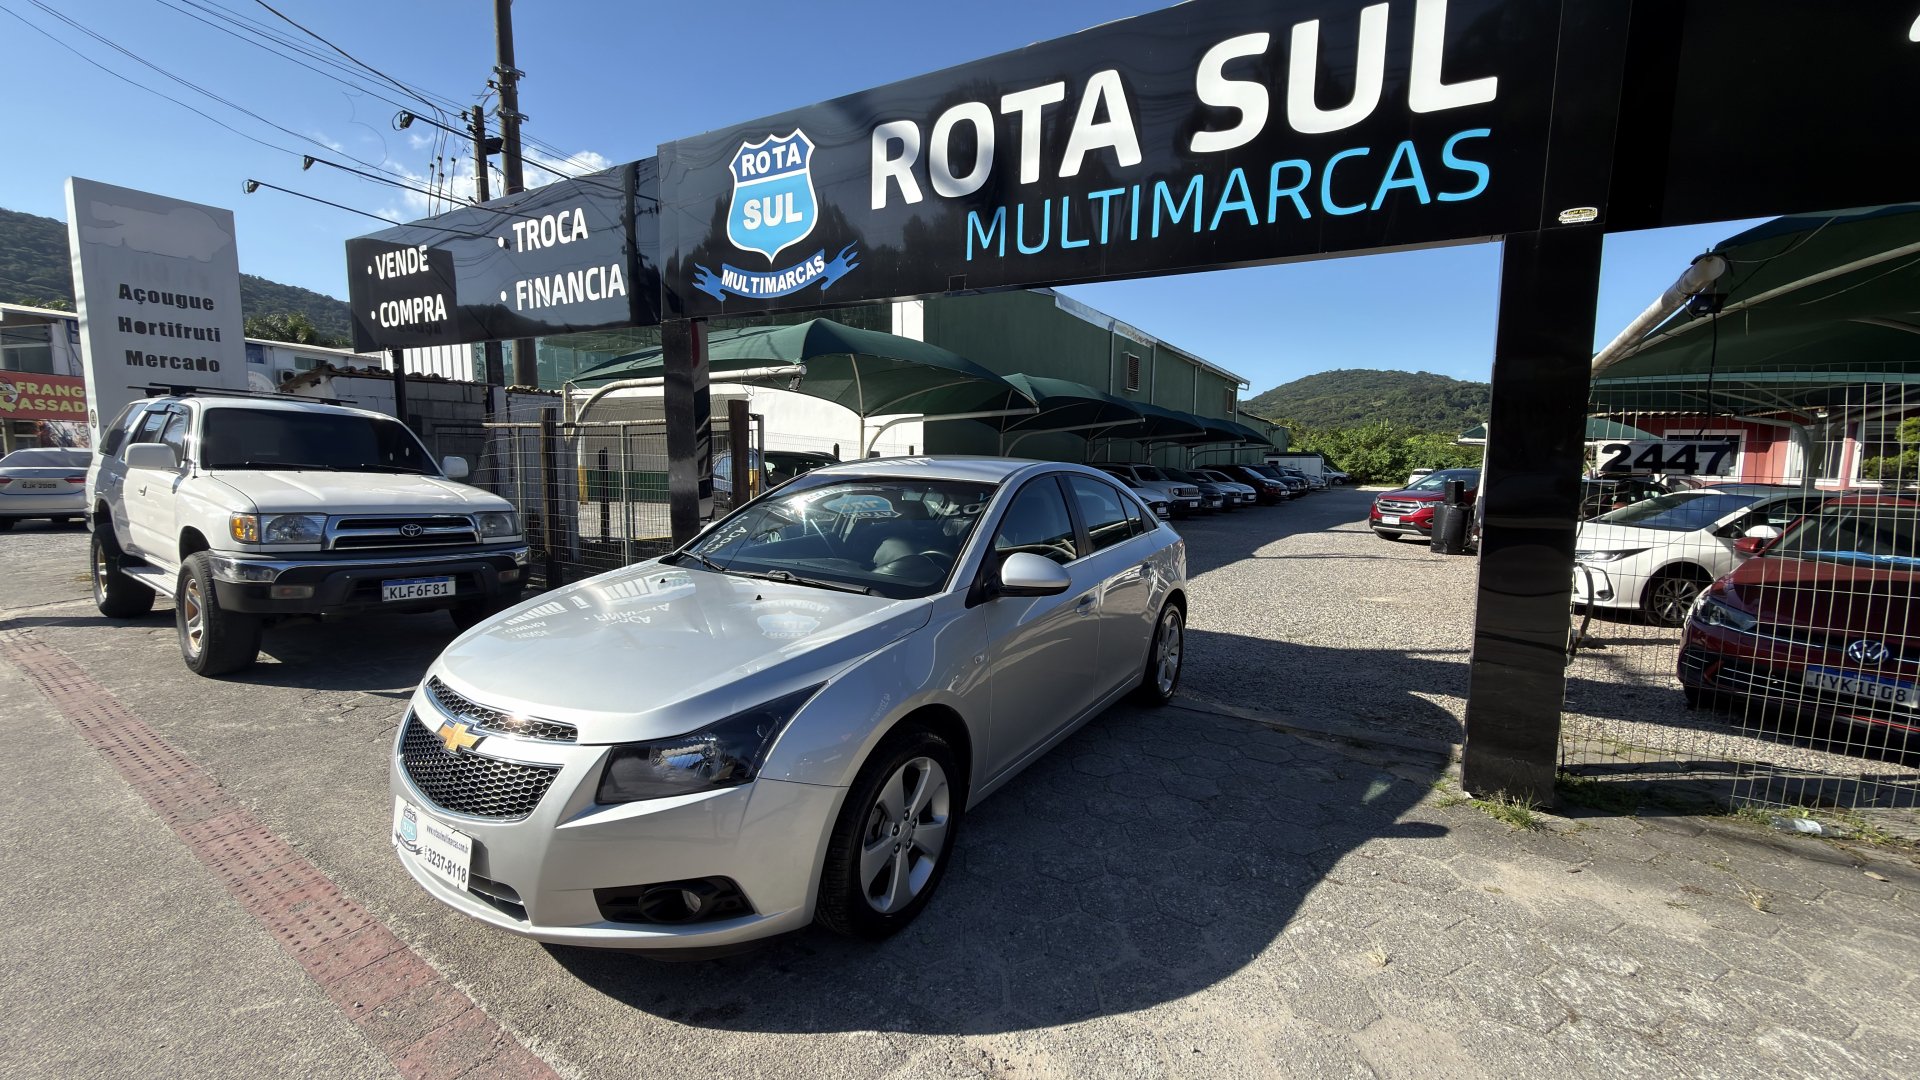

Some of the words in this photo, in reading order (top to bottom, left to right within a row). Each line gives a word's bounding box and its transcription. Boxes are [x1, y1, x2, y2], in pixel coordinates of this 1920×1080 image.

[871, 69, 1142, 210] ROTA
[1190, 0, 1498, 153] SUL
[741, 142, 802, 177] ROTA
[743, 192, 803, 230] SUL
[966, 128, 1492, 262] MULTIMARCAS
[512, 207, 589, 253] TROCA
[374, 245, 430, 280] VENDE
[721, 255, 825, 294] MULTIMARCAS
[118, 283, 215, 311] Açougue
[515, 263, 627, 311] FINANCIA
[379, 293, 448, 328] COMPRA
[118, 316, 221, 343] Hortifruti
[125, 349, 220, 373] Mercado
[1600, 443, 1732, 475] 2447
[389, 583, 449, 599] KLF6F81
[427, 848, 467, 883] 3237-8118
